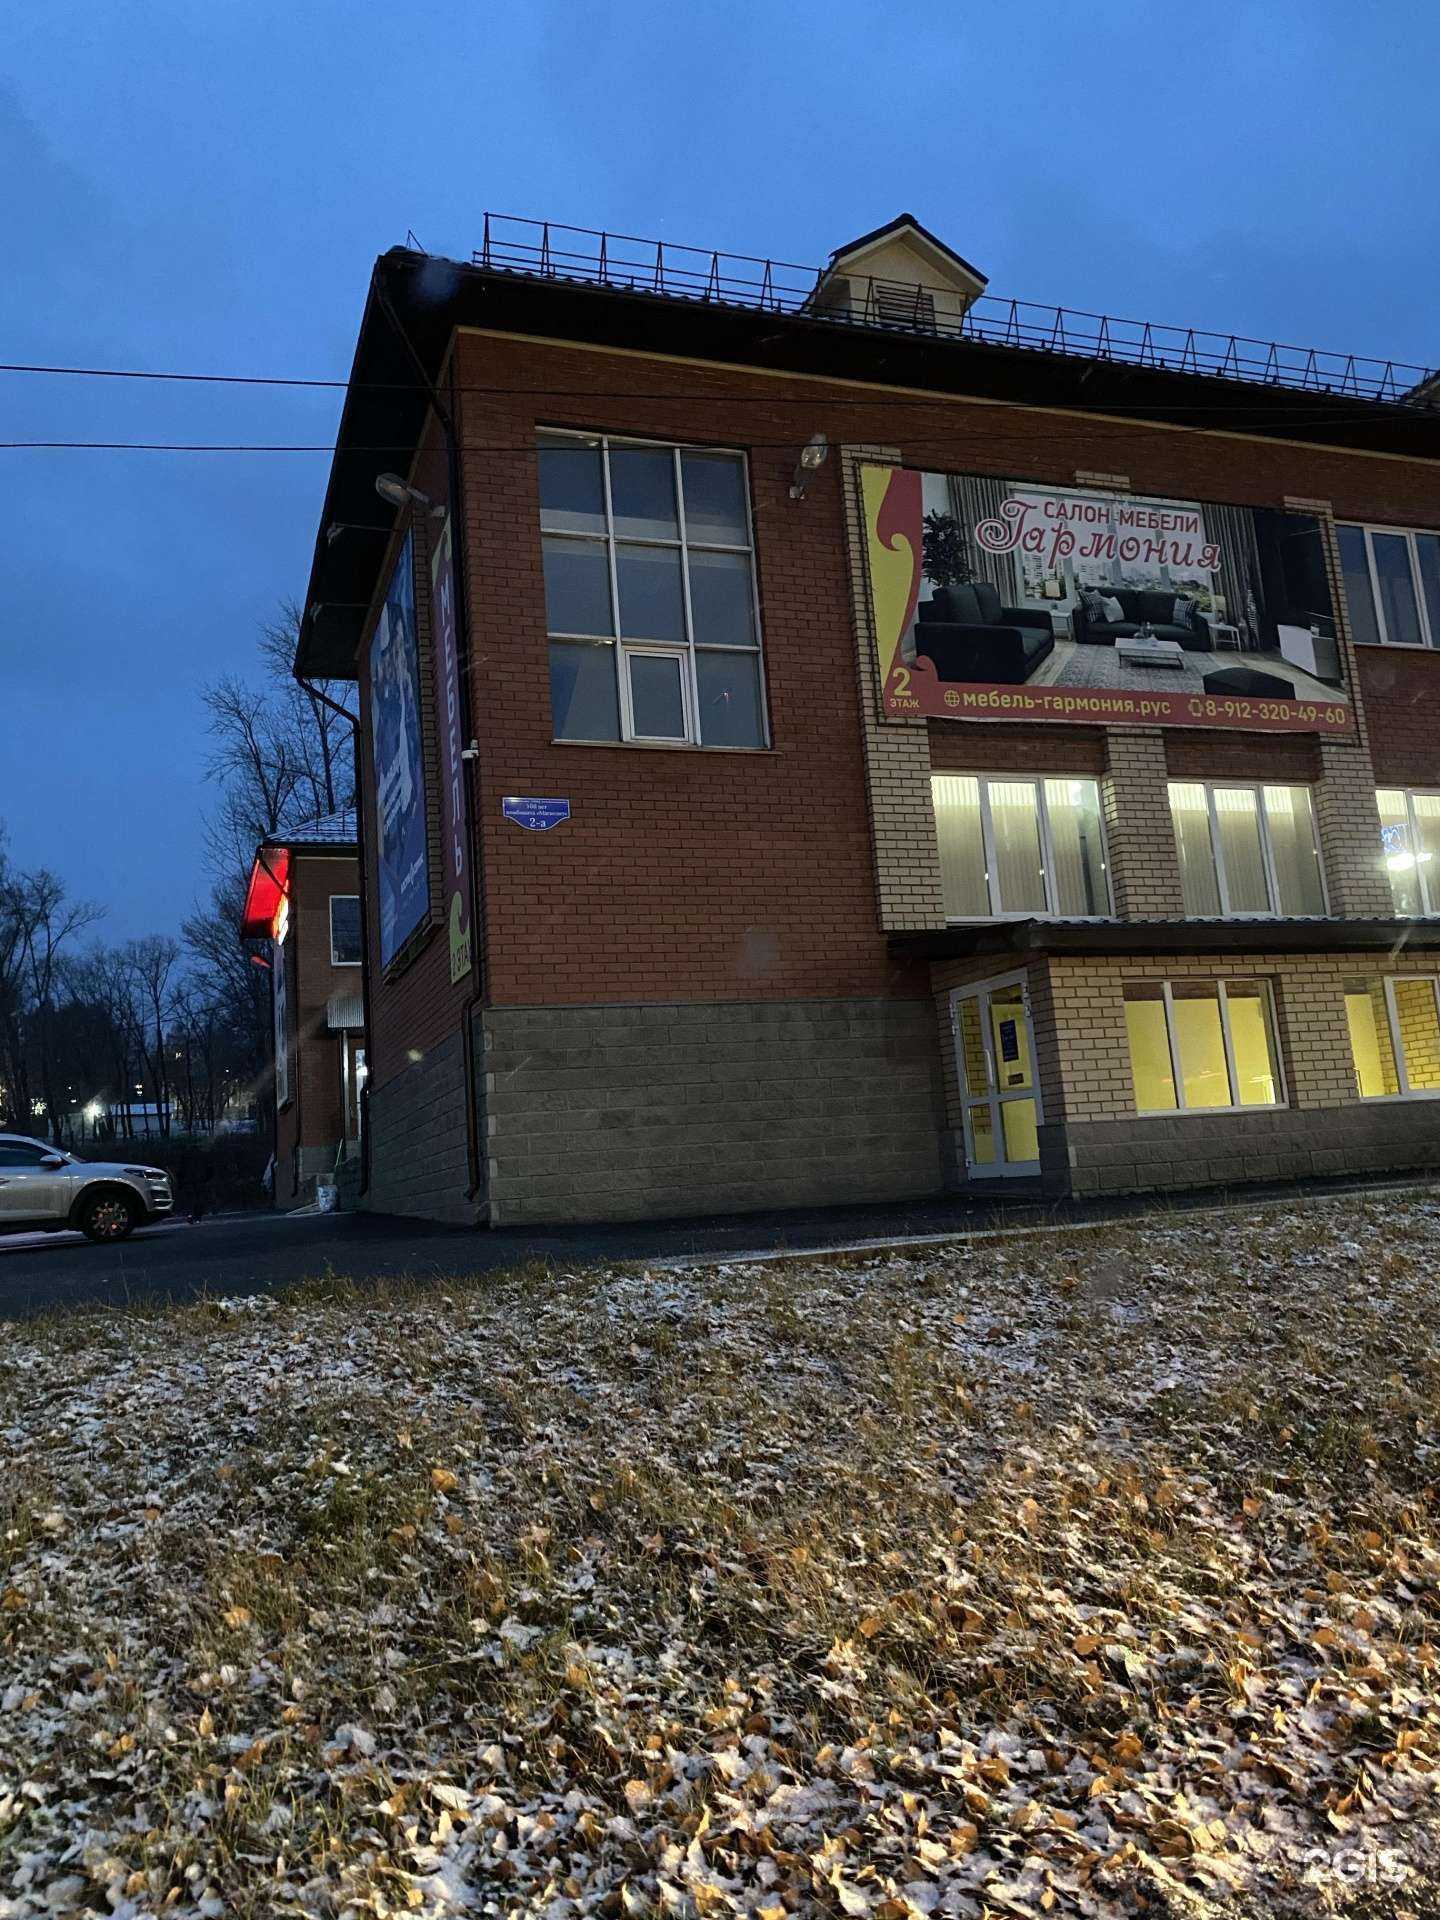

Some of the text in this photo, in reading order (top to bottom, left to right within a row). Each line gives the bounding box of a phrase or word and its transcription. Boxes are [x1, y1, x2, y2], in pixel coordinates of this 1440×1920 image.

[1043, 501, 1199, 534] САЛОН МЕБЕЛИ
[976, 499, 1221, 572] Гармония
[892, 668, 912, 696] 2
[889, 697, 920, 708] ЭТАЖ
[963, 691, 1172, 717] мебель-гармония.рус
[1205, 701, 1346, 724] 8-912-320-49-60
[440, 573, 464, 879] МЕБЕЛЬ
